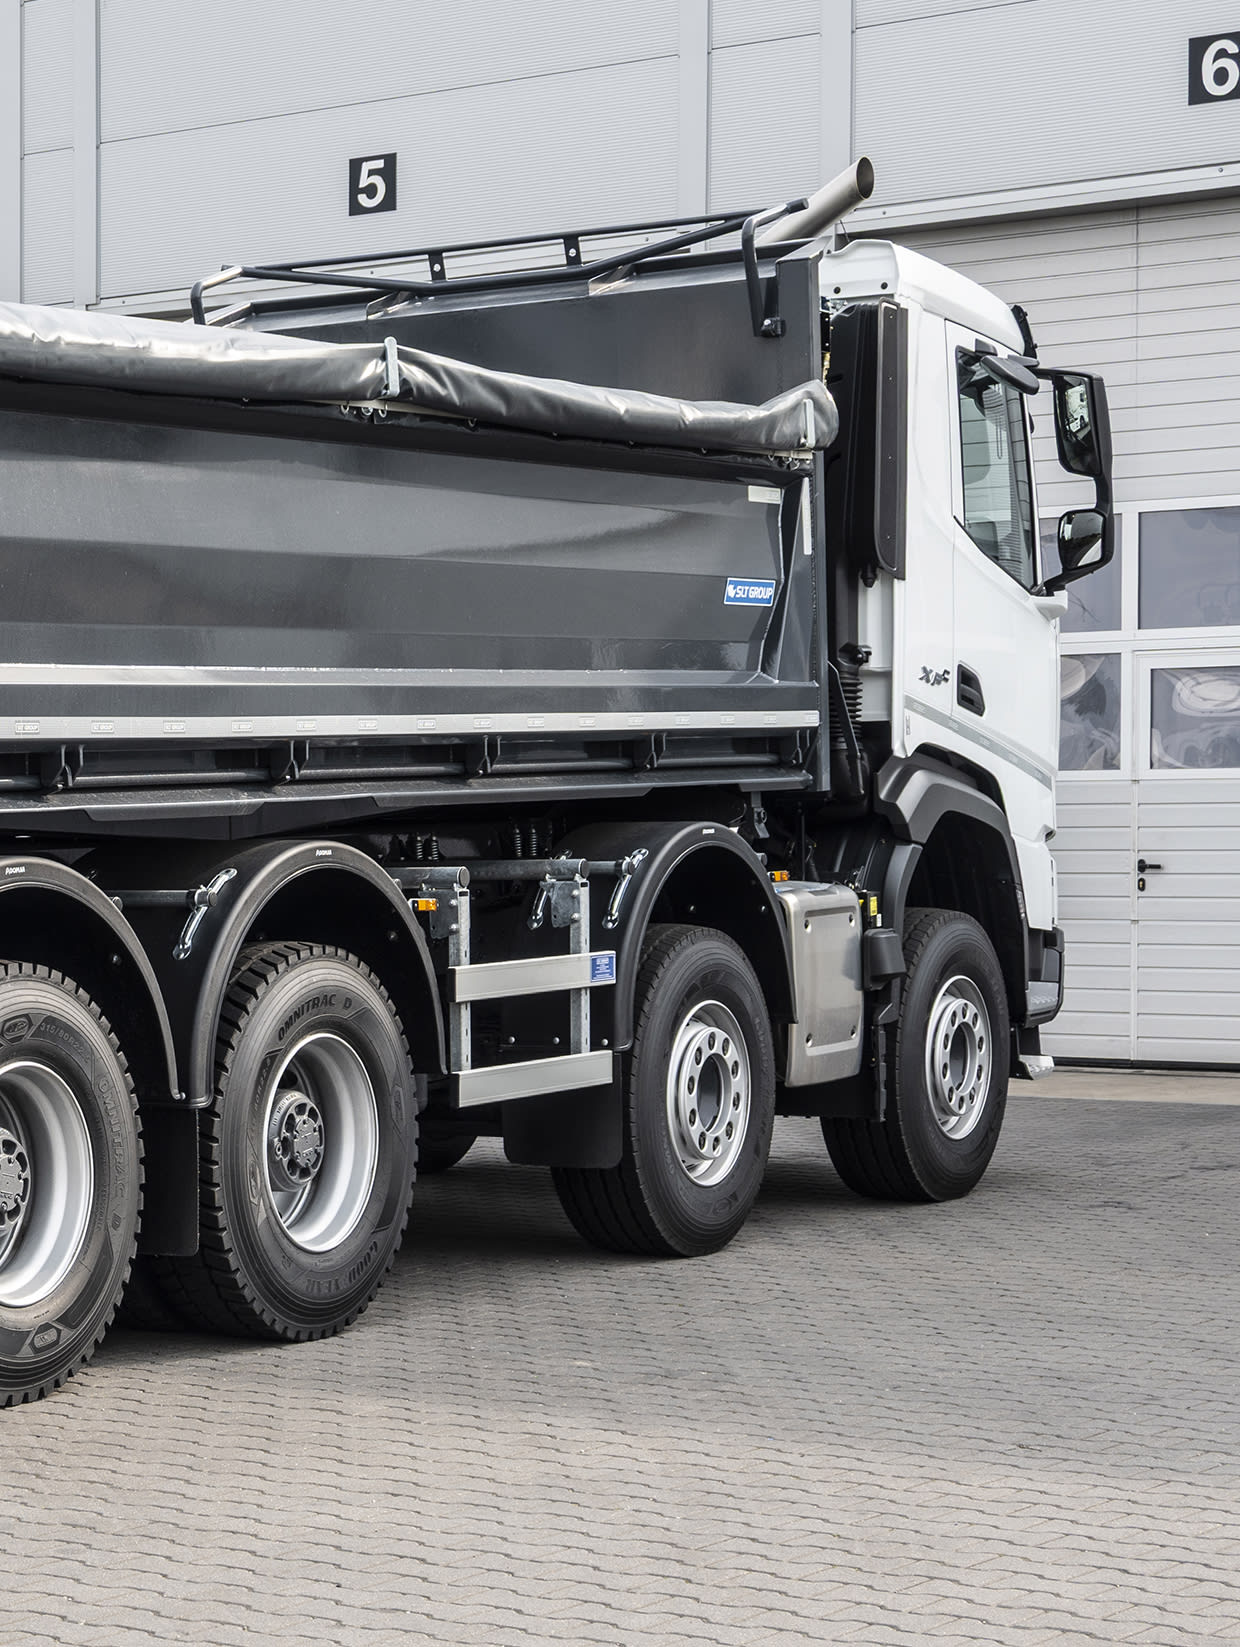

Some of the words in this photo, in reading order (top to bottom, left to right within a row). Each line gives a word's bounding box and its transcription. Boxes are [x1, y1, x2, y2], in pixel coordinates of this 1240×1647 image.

[1202, 39, 1240, 96] 6
[358, 159, 386, 208] 5
[736, 586, 749, 598] SLT
[749, 586, 773, 599] GROUP
[278, 994, 336, 1040] OMNITRAC
[343, 997, 352, 1010] D
[98, 1078, 125, 1198] OMNITRAC
[111, 1212, 122, 1232] D
